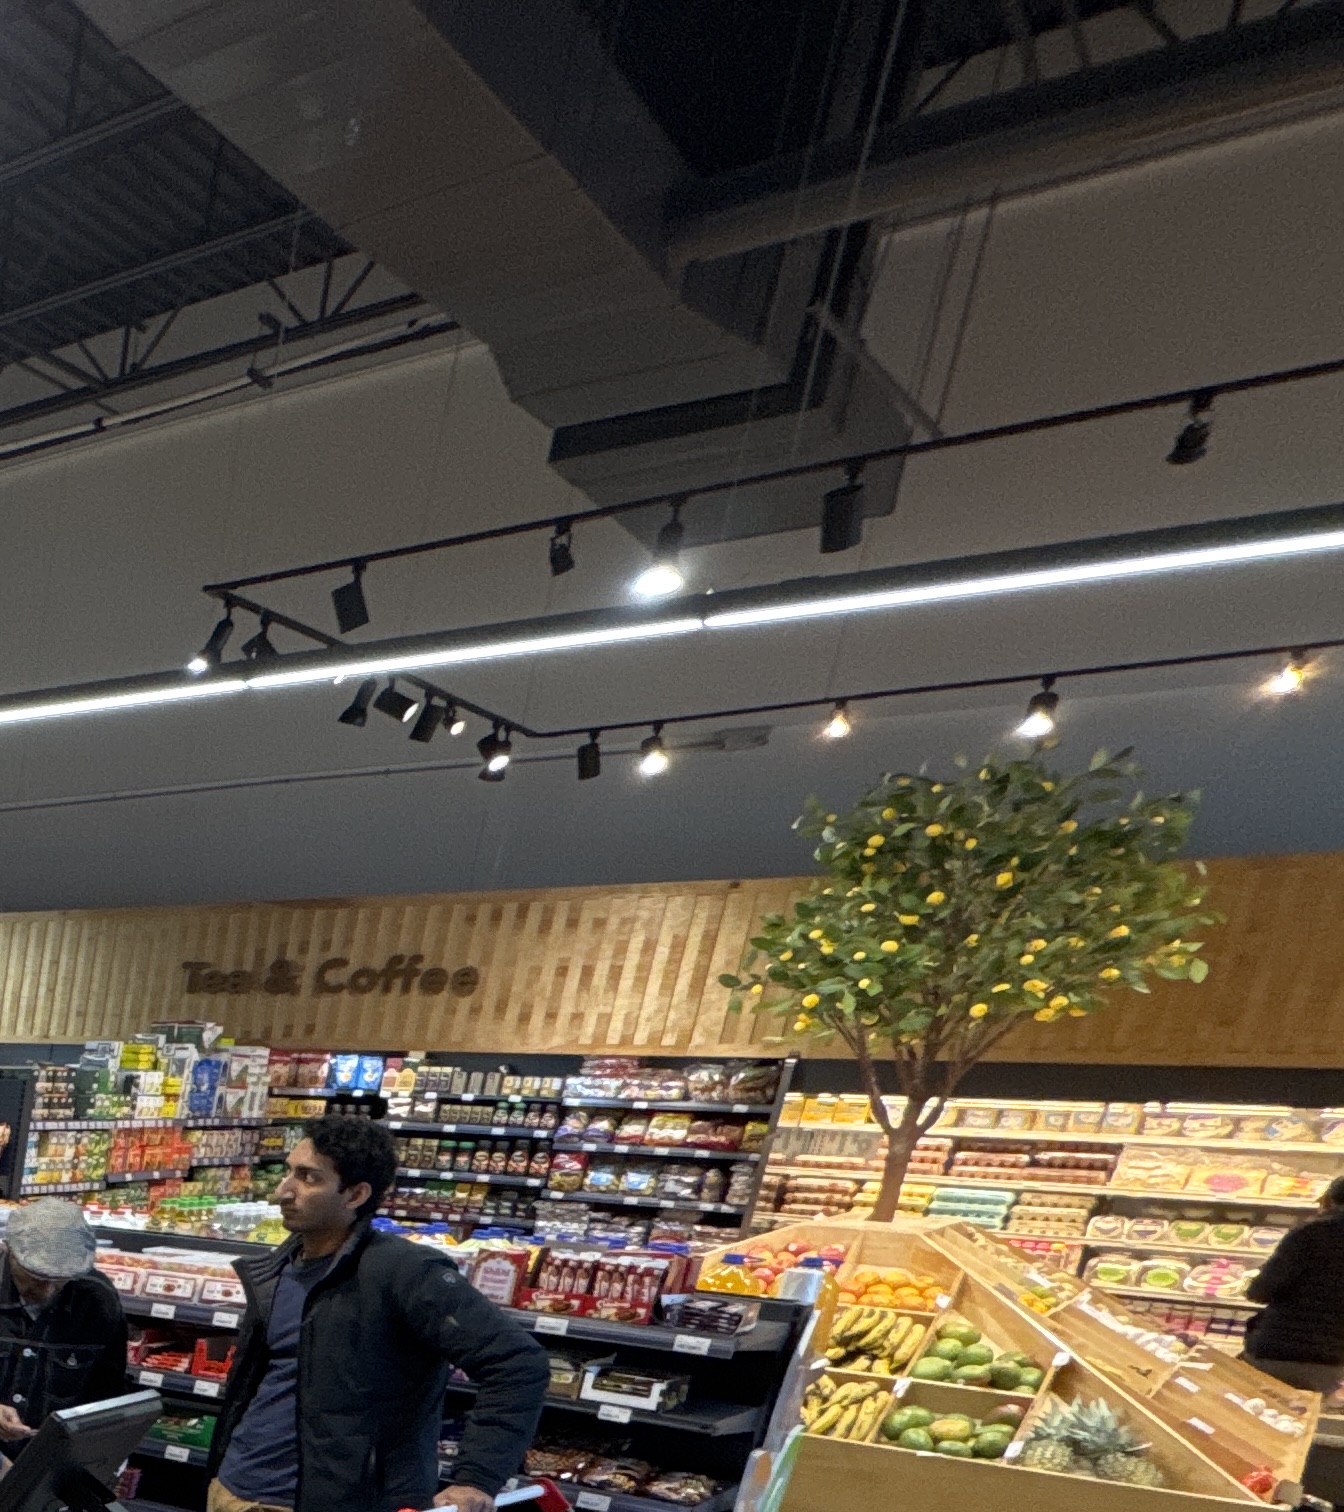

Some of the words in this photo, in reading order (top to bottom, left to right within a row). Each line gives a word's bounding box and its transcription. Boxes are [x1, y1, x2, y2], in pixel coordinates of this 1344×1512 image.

[182, 961, 255, 995] Tea
[263, 956, 302, 995] &
[315, 953, 480, 997] Coffee
